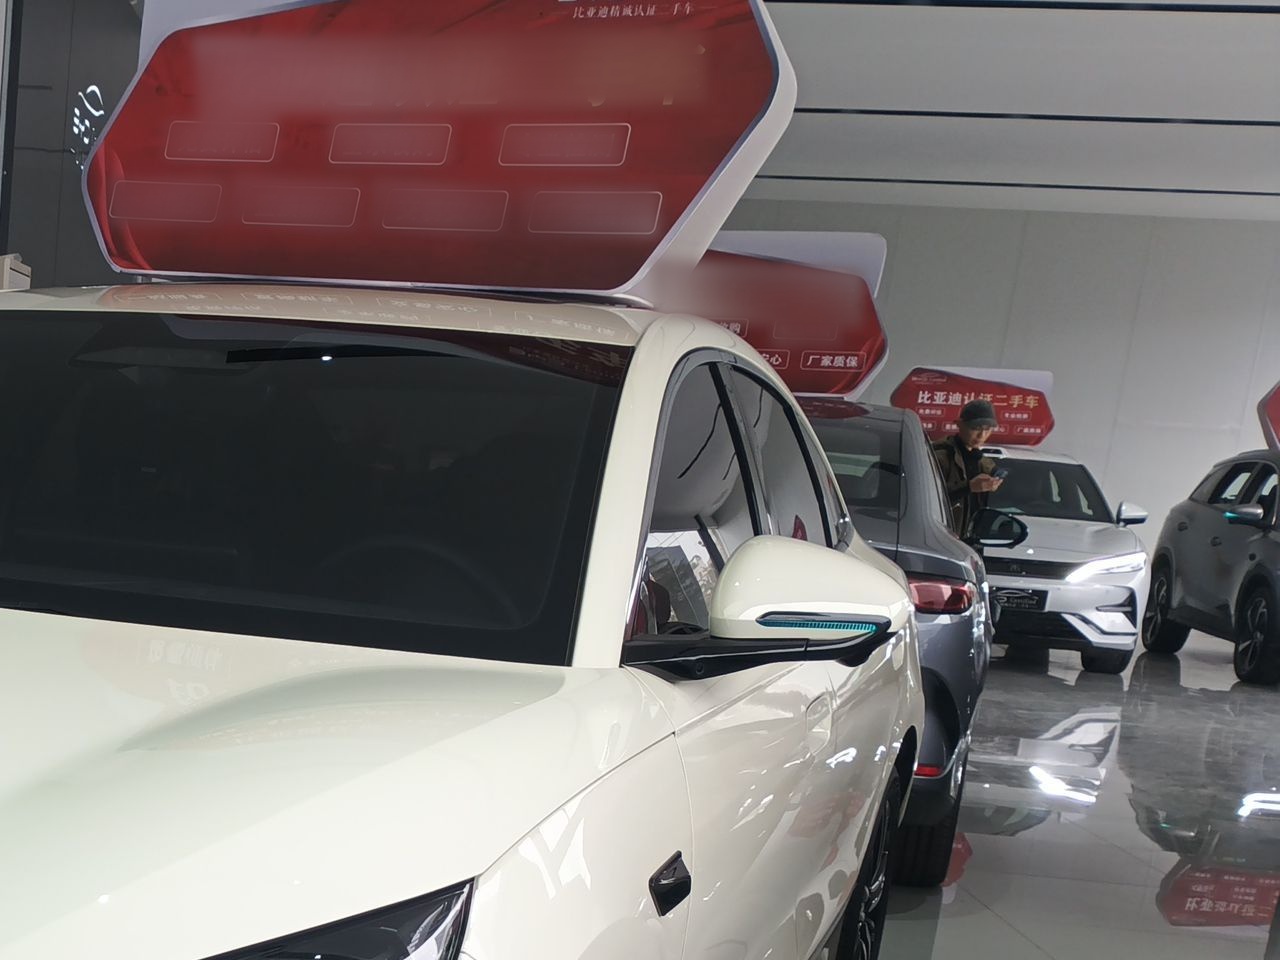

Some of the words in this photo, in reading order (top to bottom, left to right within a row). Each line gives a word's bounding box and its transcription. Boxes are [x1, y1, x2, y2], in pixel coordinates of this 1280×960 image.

[807, 355, 858, 367] 厂家质保
[917, 390, 1039, 408] 比亚迪认证二手车
